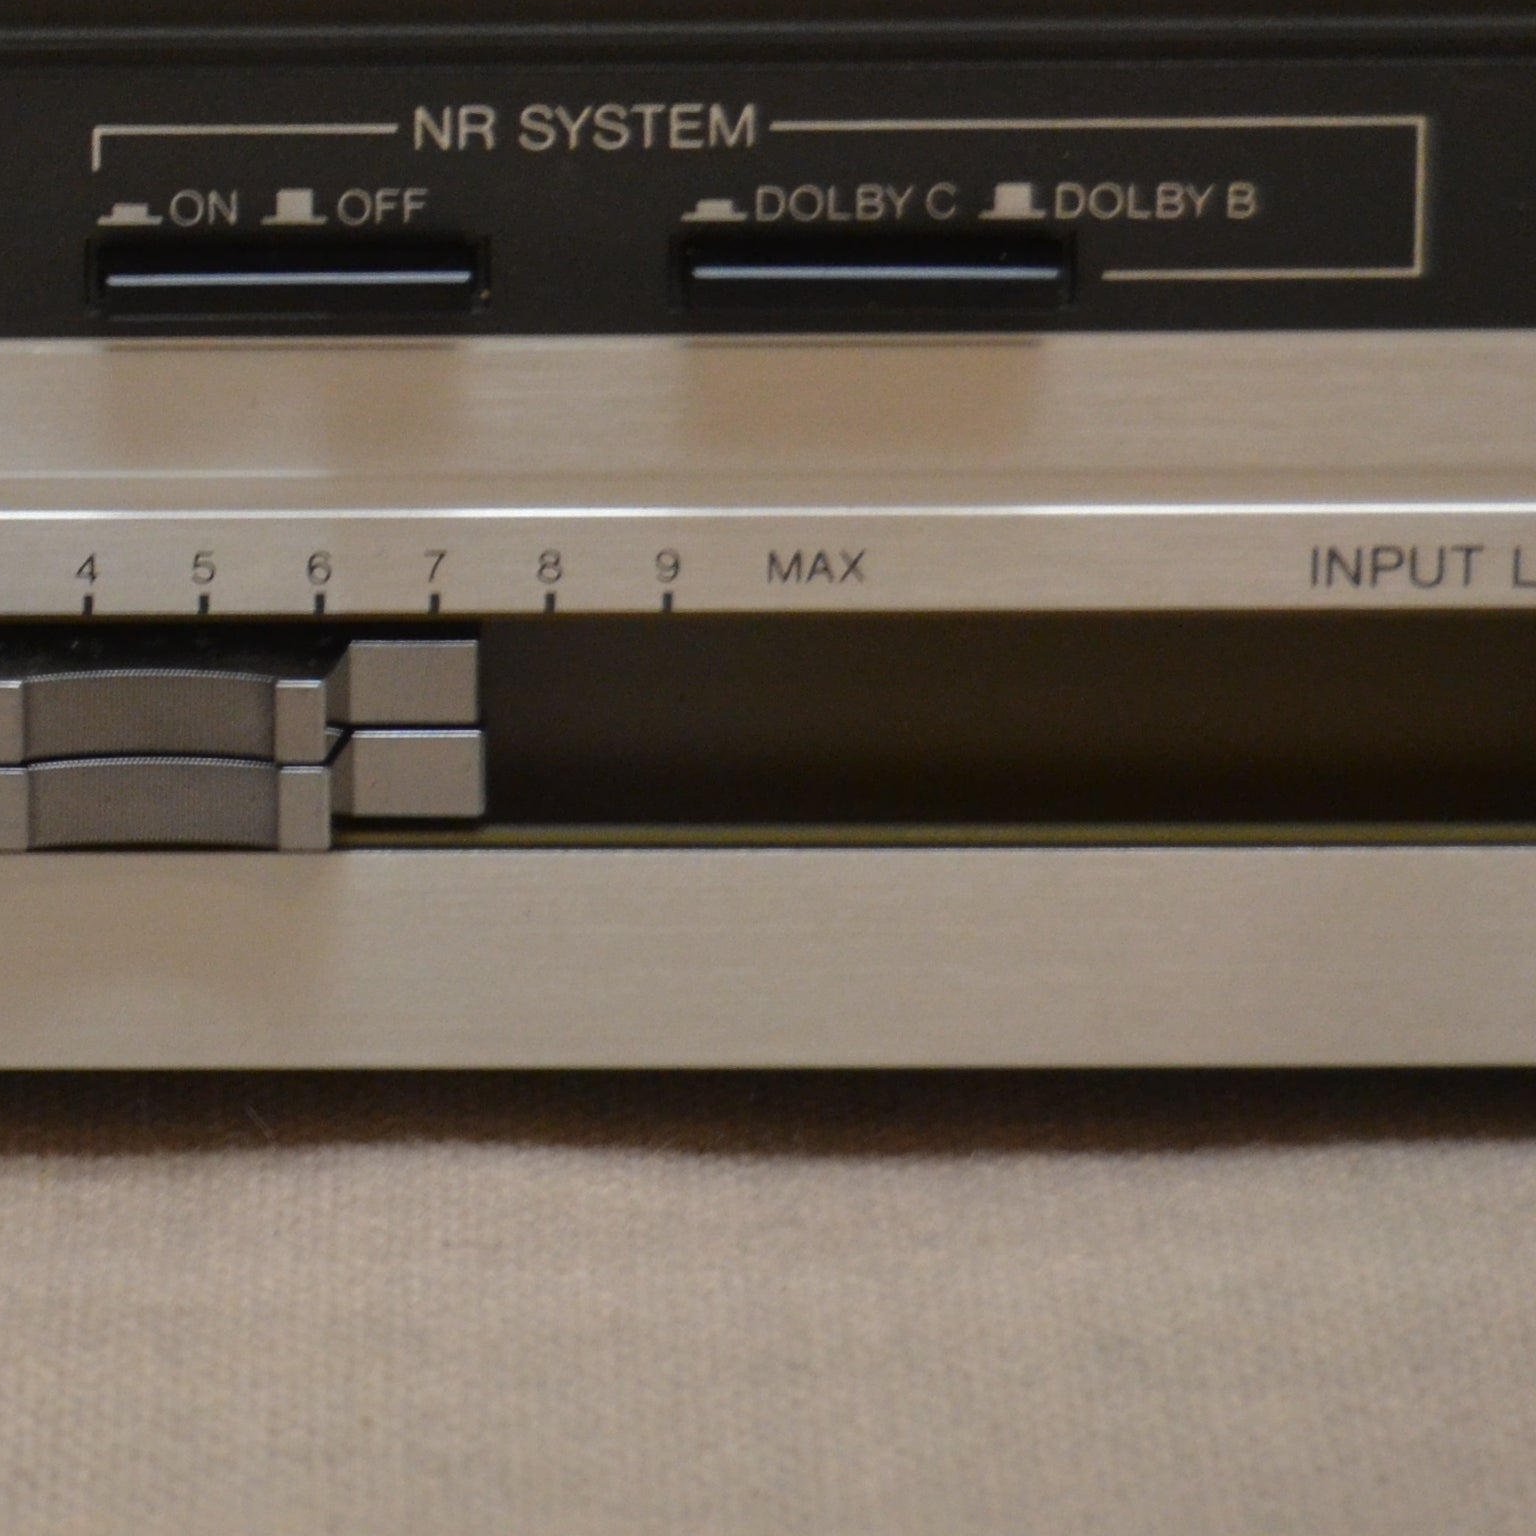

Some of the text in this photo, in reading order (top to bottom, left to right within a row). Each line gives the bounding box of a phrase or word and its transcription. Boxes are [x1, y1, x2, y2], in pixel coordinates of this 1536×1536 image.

[413, 102, 758, 152] NR SYSTEM
[168, 189, 238, 226] ON
[336, 188, 428, 225] OFF
[754, 182, 958, 222] DOLBY C
[1054, 181, 1258, 220] DOLBY B
[75, 552, 99, 585] 4
[191, 551, 217, 585] 5
[306, 551, 332, 585] 6
[423, 550, 446, 583] 7
[536, 549, 563, 584] 8
[655, 549, 681, 583] 9
[766, 548, 866, 583] MAX
[1310, 544, 1485, 588] INPUT
